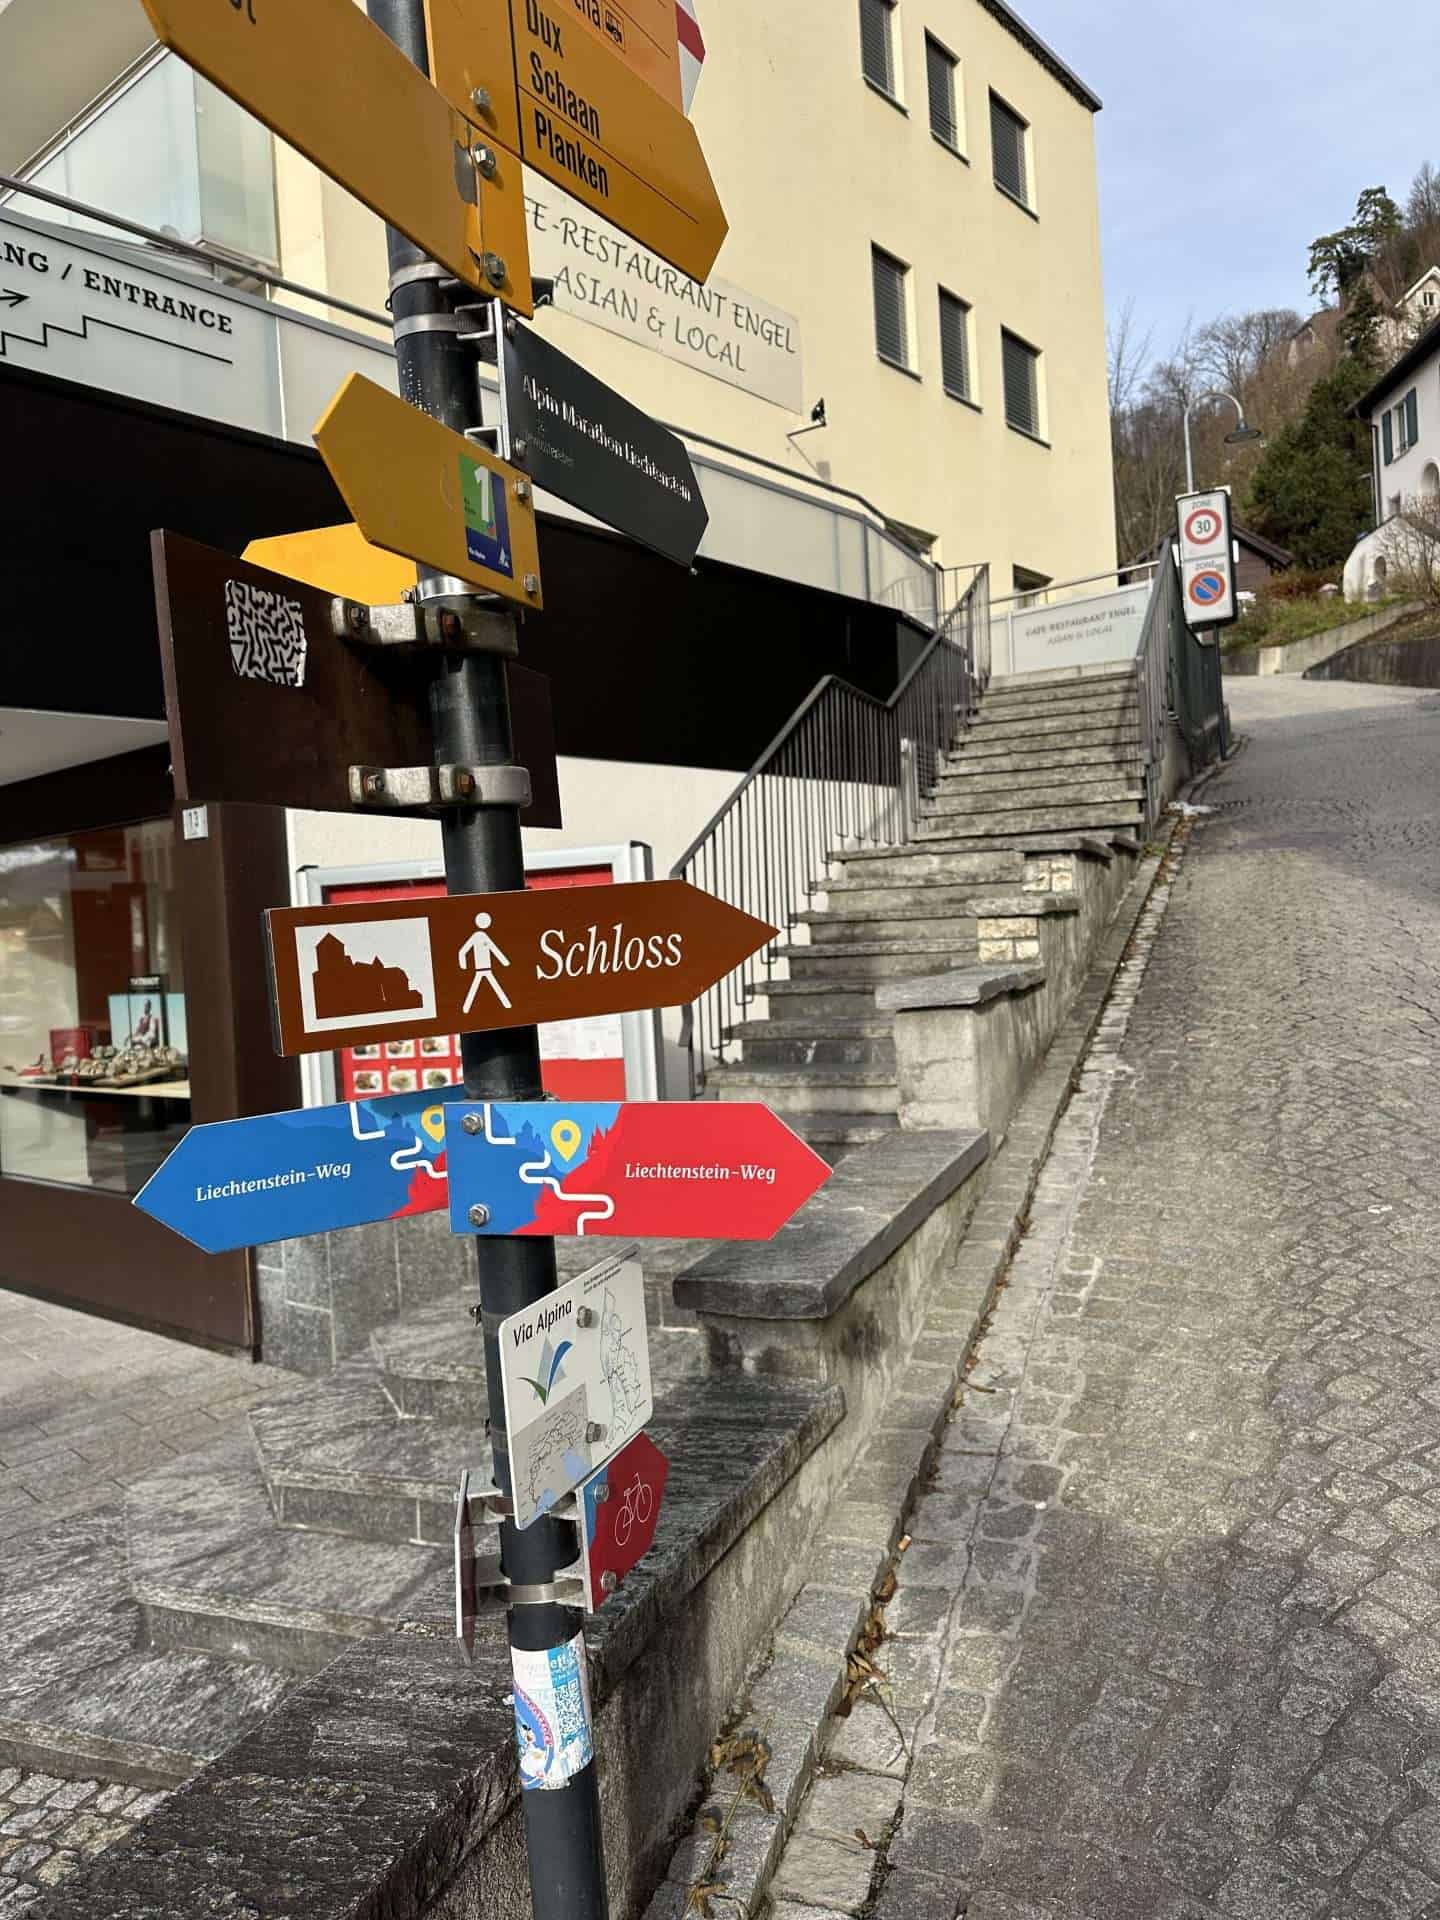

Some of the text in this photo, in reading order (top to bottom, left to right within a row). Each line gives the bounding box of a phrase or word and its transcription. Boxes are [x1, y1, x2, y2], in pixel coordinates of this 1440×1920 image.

[526, 0, 564, 58] Dux
[529, 51, 600, 140] Schaan
[534, 107, 609, 198] Planken
[0, 241, 233, 335] NG / ENTRANCE
[554, 265, 747, 373] ASIAN & LOCAL
[732, 302, 797, 353] ENGEL
[522, 375, 559, 417] Alpin
[562, 400, 623, 458] Marathon
[625, 441, 691, 503] Liechtenstein
[474, 464, 490, 523] 1
[1195, 519, 1211, 535] 30
[535, 923, 682, 980] Schloss
[195, 1163, 352, 1202] Liechtenstein-Weg
[624, 1162, 777, 1185] Liechtenstein-Weg
[513, 1300, 573, 1348] Via Alpina
